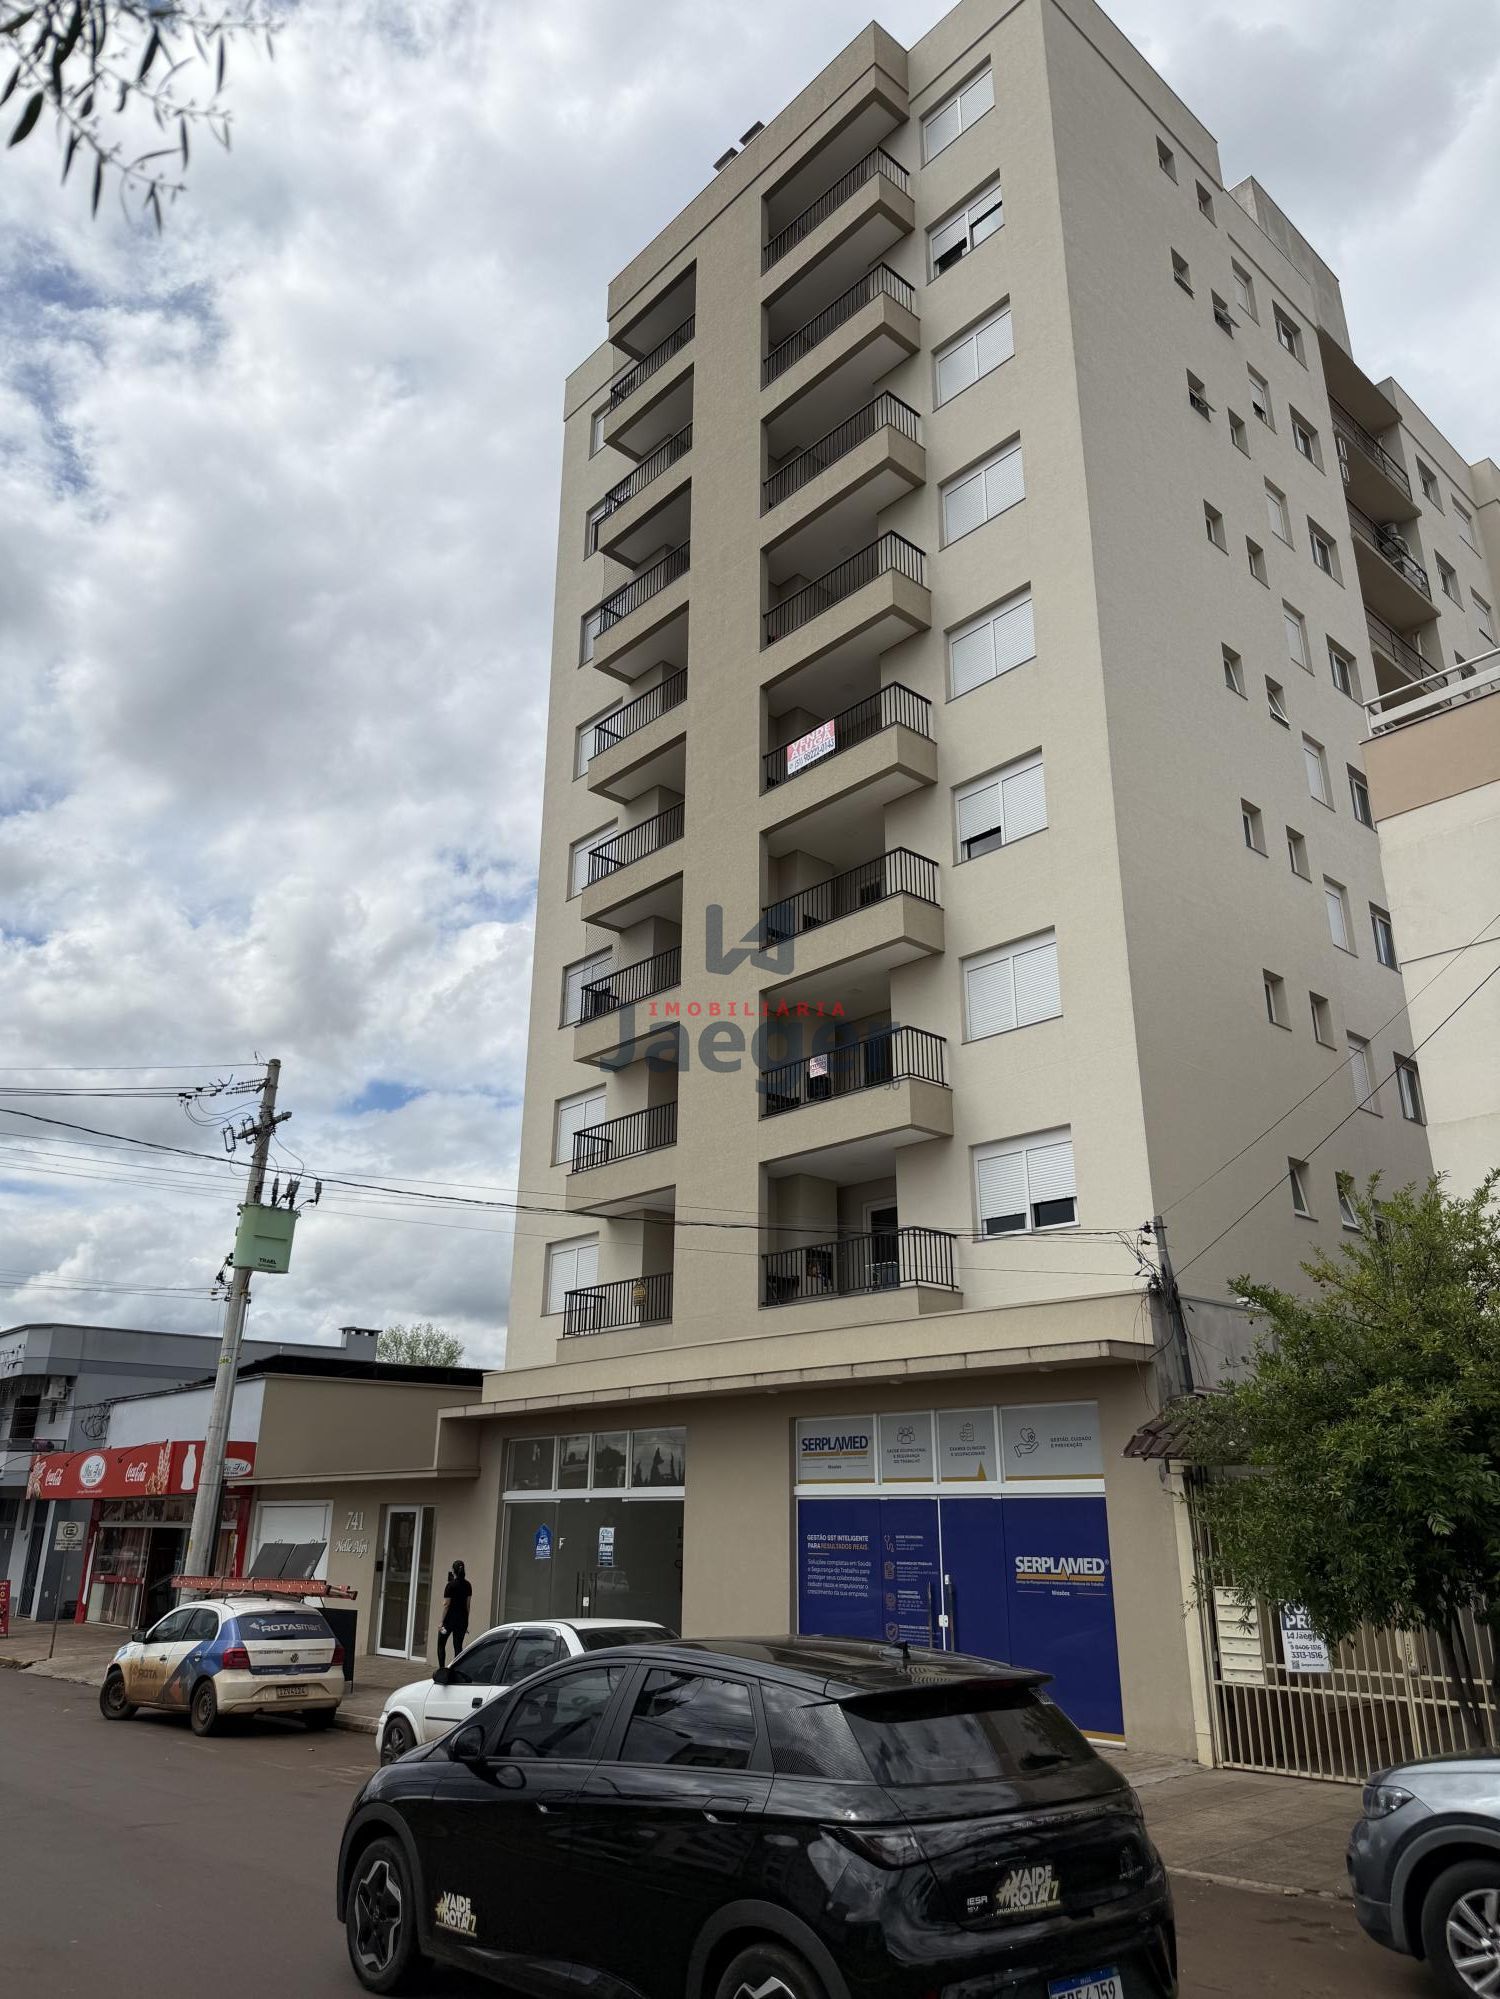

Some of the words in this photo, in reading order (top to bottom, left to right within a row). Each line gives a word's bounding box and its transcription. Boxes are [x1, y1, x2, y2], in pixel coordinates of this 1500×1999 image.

[790, 731, 833, 760] ALUGA
[801, 1435, 869, 1453] SERPLAMED
[345, 1511, 365, 1531] 741
[1015, 1556, 1105, 1576] SERPLAMED
[1291, 1651, 1323, 1659] 3313-1516
[138, 1668, 158, 1680] ROTA
[966, 1895, 988, 1906] IESA
